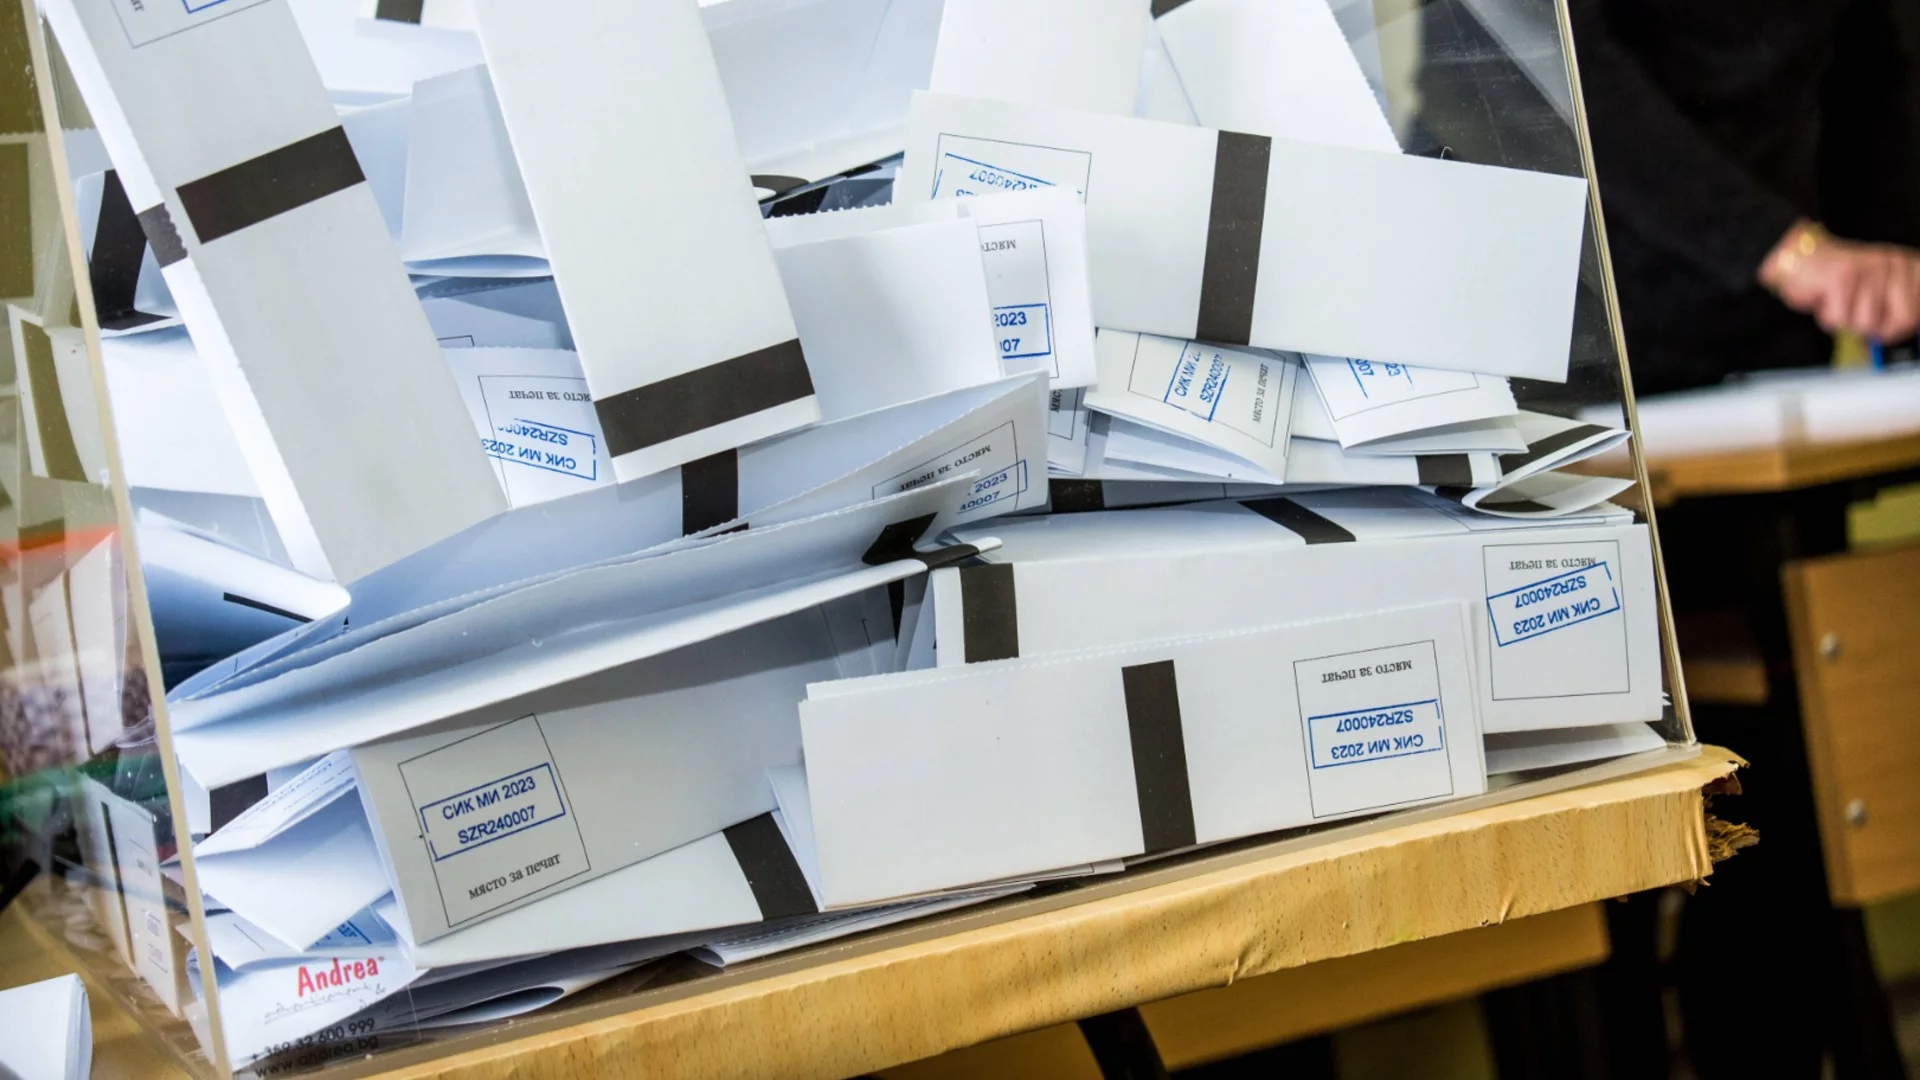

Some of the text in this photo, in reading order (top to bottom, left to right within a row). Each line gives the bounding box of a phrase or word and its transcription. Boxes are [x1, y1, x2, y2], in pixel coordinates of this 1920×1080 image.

[508, 390, 592, 402] ясто за печат
[518, 446, 542, 462] МИ
[545, 452, 577, 470] СИК
[954, 444, 991, 468] място
[938, 466, 951, 477] за
[1509, 557, 1597, 571] място за печат
[1514, 575, 1587, 609] SZR240007
[1513, 597, 1601, 635] СИК МИ 2023
[1321, 660, 1413, 684] място за печат
[1336, 709, 1414, 733] SZR240007
[1330, 734, 1424, 760] СИК МИ 2023
[442, 776, 536, 820] СИК МИ 2023
[458, 805, 536, 844] SZR240007
[468, 853, 561, 900] място за печат
[297, 956, 379, 998] Andrea
[318, 1025, 345, 1044] 600
[347, 1016, 376, 1036] 999
